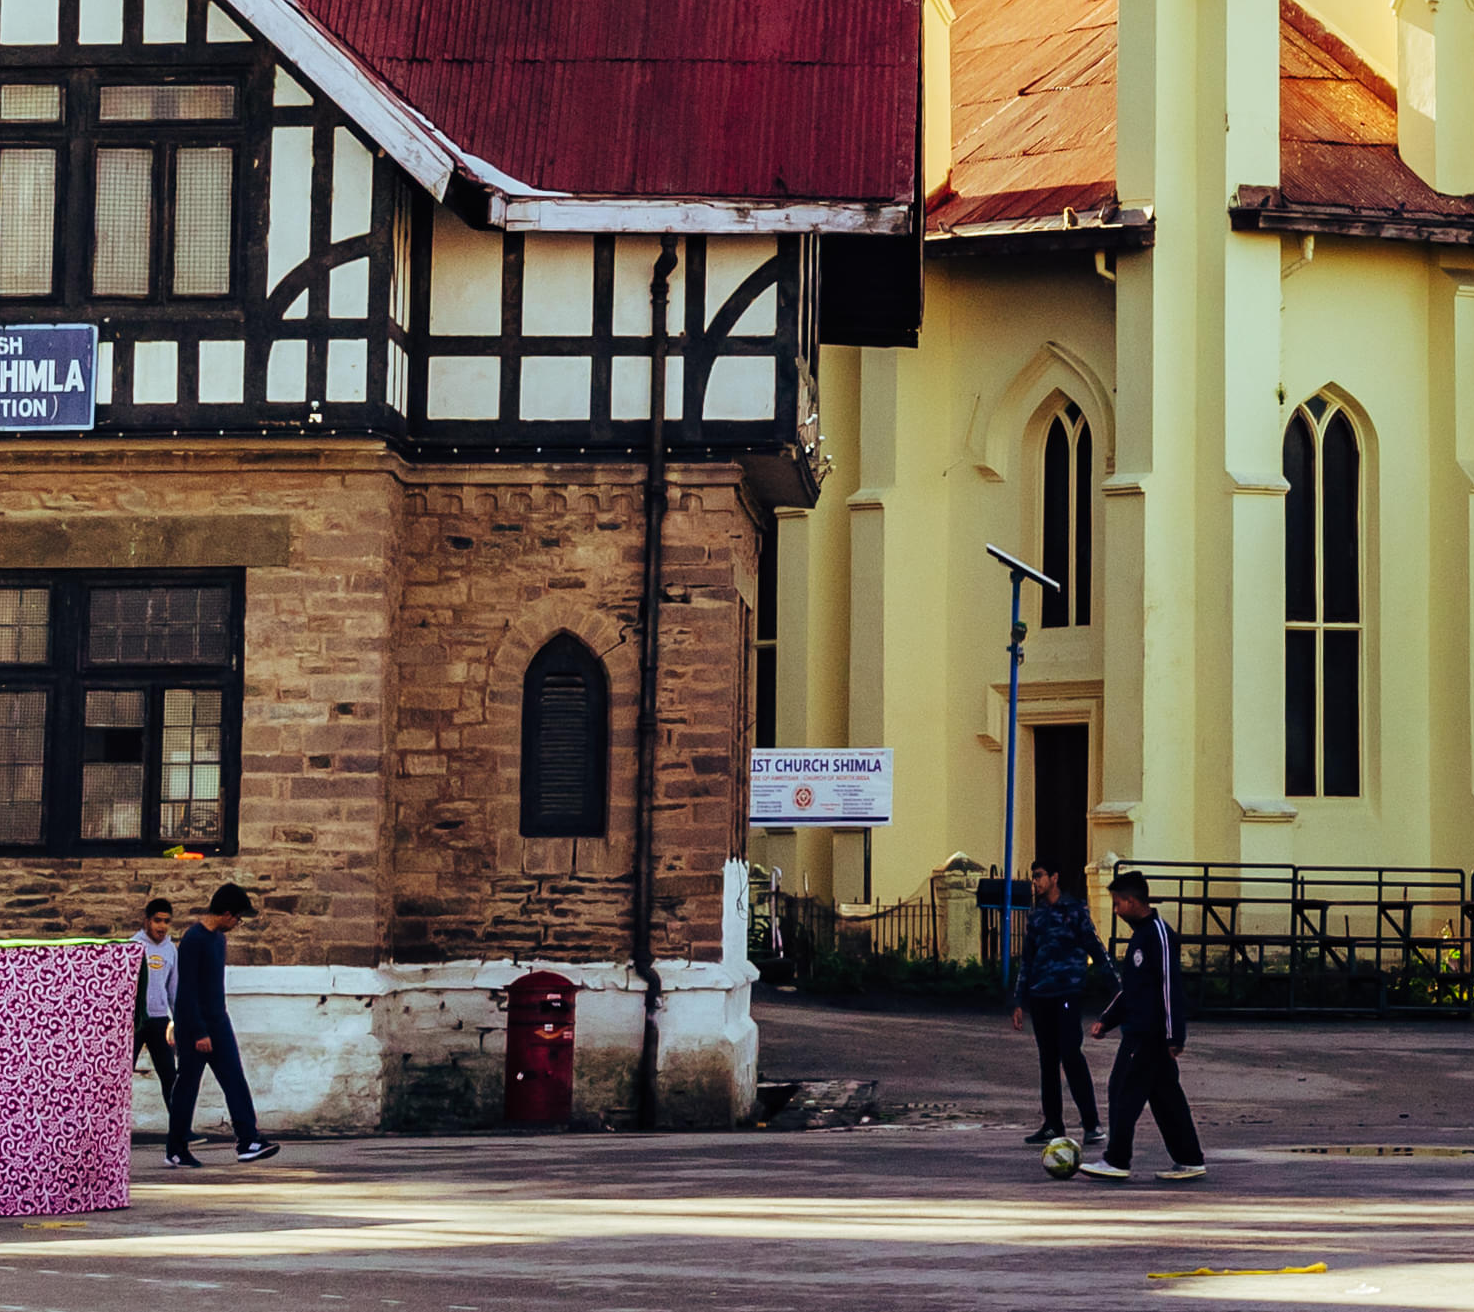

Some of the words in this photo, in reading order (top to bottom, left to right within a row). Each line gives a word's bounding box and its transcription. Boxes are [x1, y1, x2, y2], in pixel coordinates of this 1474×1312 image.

[751, 758, 772, 772] IST
[774, 758, 829, 772] CHURCH
[833, 758, 882, 772] SHIMLA
